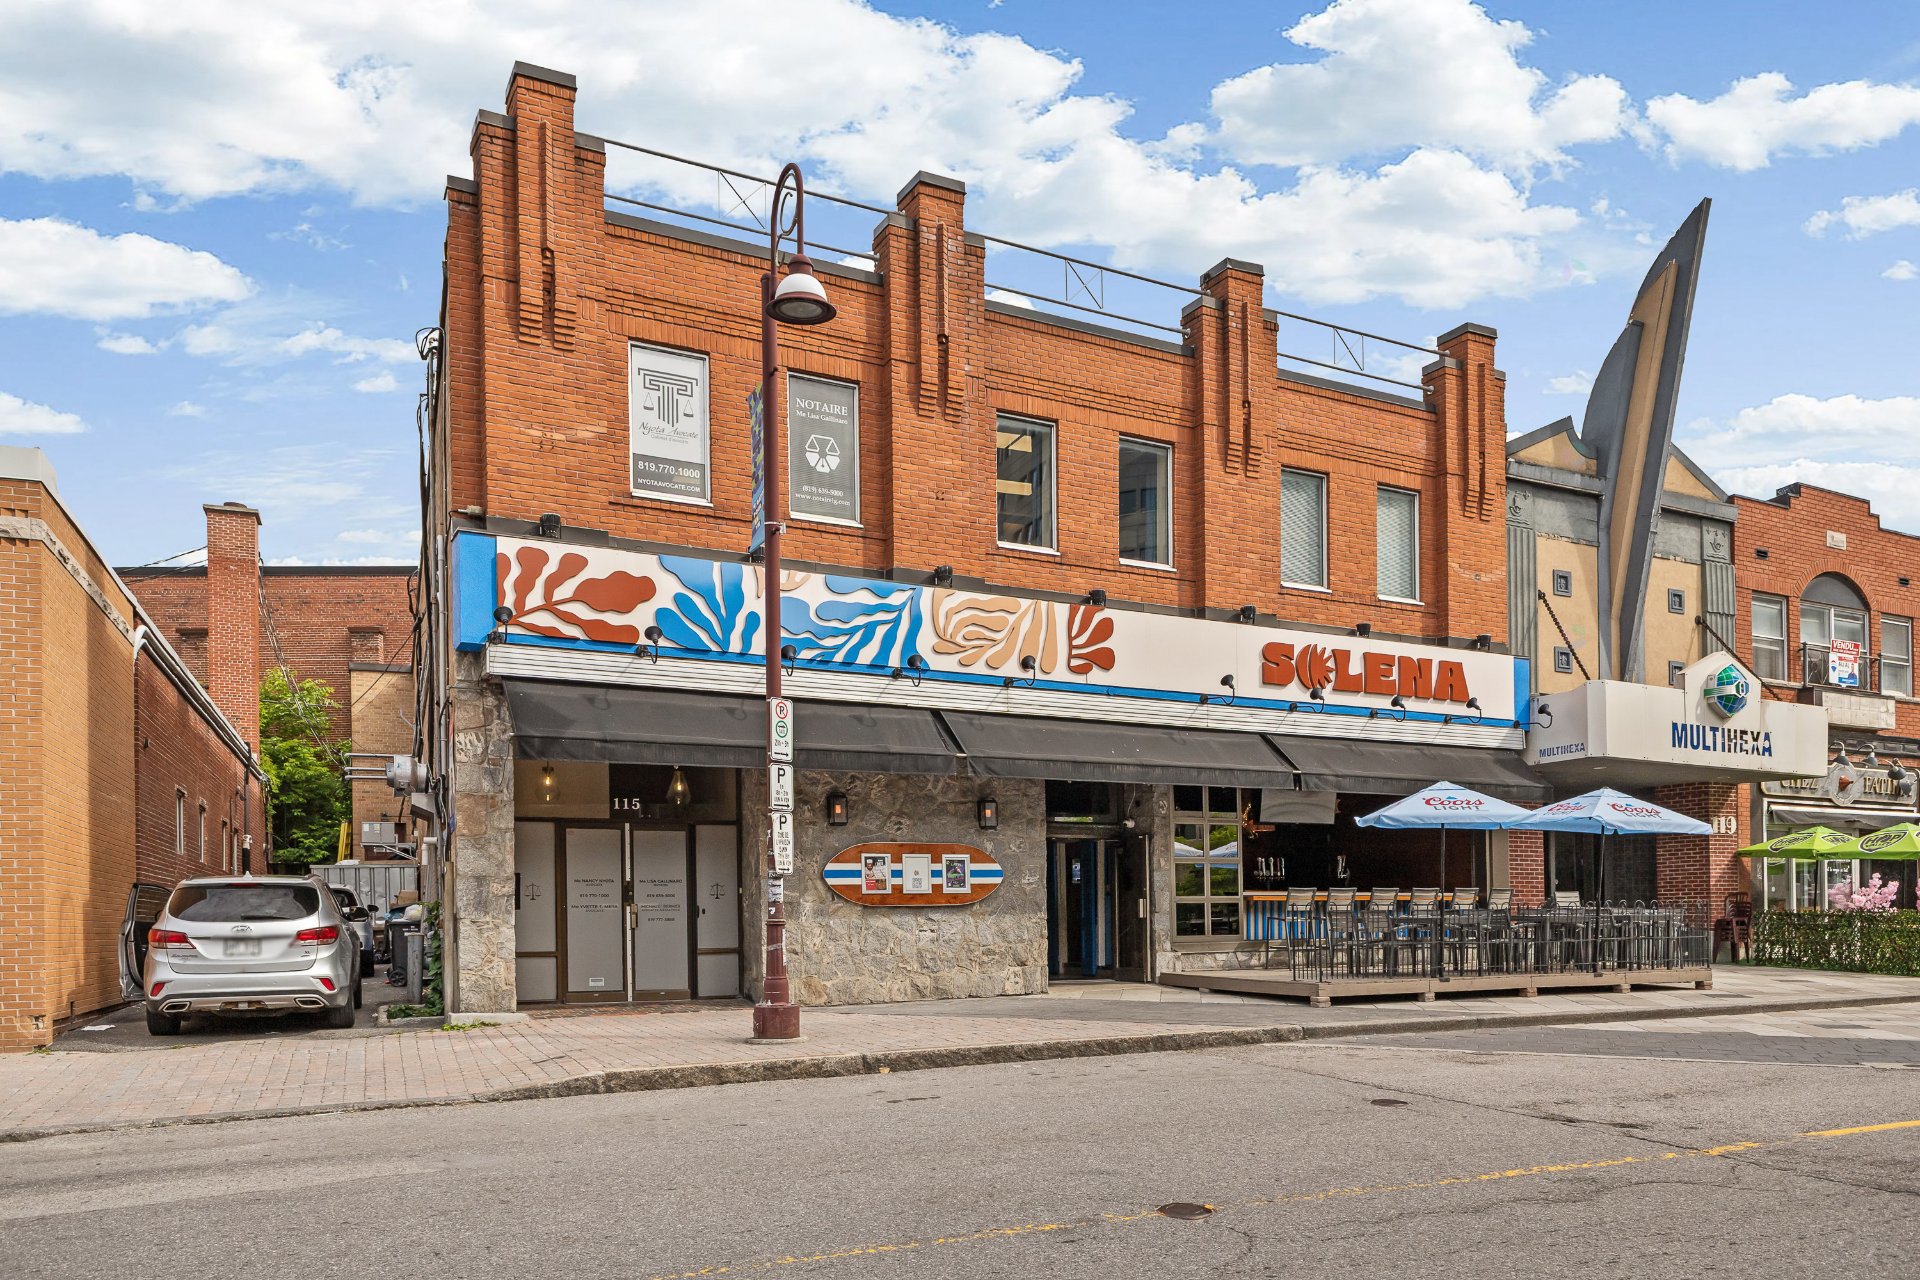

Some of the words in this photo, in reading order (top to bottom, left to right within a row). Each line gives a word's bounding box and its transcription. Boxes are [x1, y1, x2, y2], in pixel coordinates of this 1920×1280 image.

[796, 397, 848, 416] NOTAIRE
[638, 422, 665, 436] Nyota
[637, 460, 701, 479] 819.770.1000
[637, 478, 701, 493] NYOTAAVOCATE.COM
[1832, 640, 1855, 651] VENDU
[1671, 721, 1773, 758] MULTIHEXA
[1539, 742, 1586, 759] MULTIHEXA
[777, 767, 786, 784] P
[613, 797, 641, 810] 115
[1423, 796, 1485, 807] Coors
[1607, 802, 1662, 815] Coors
[779, 814, 788, 830] P
[1624, 811, 1663, 820] LIGHT
[1711, 816, 1737, 835] 119
